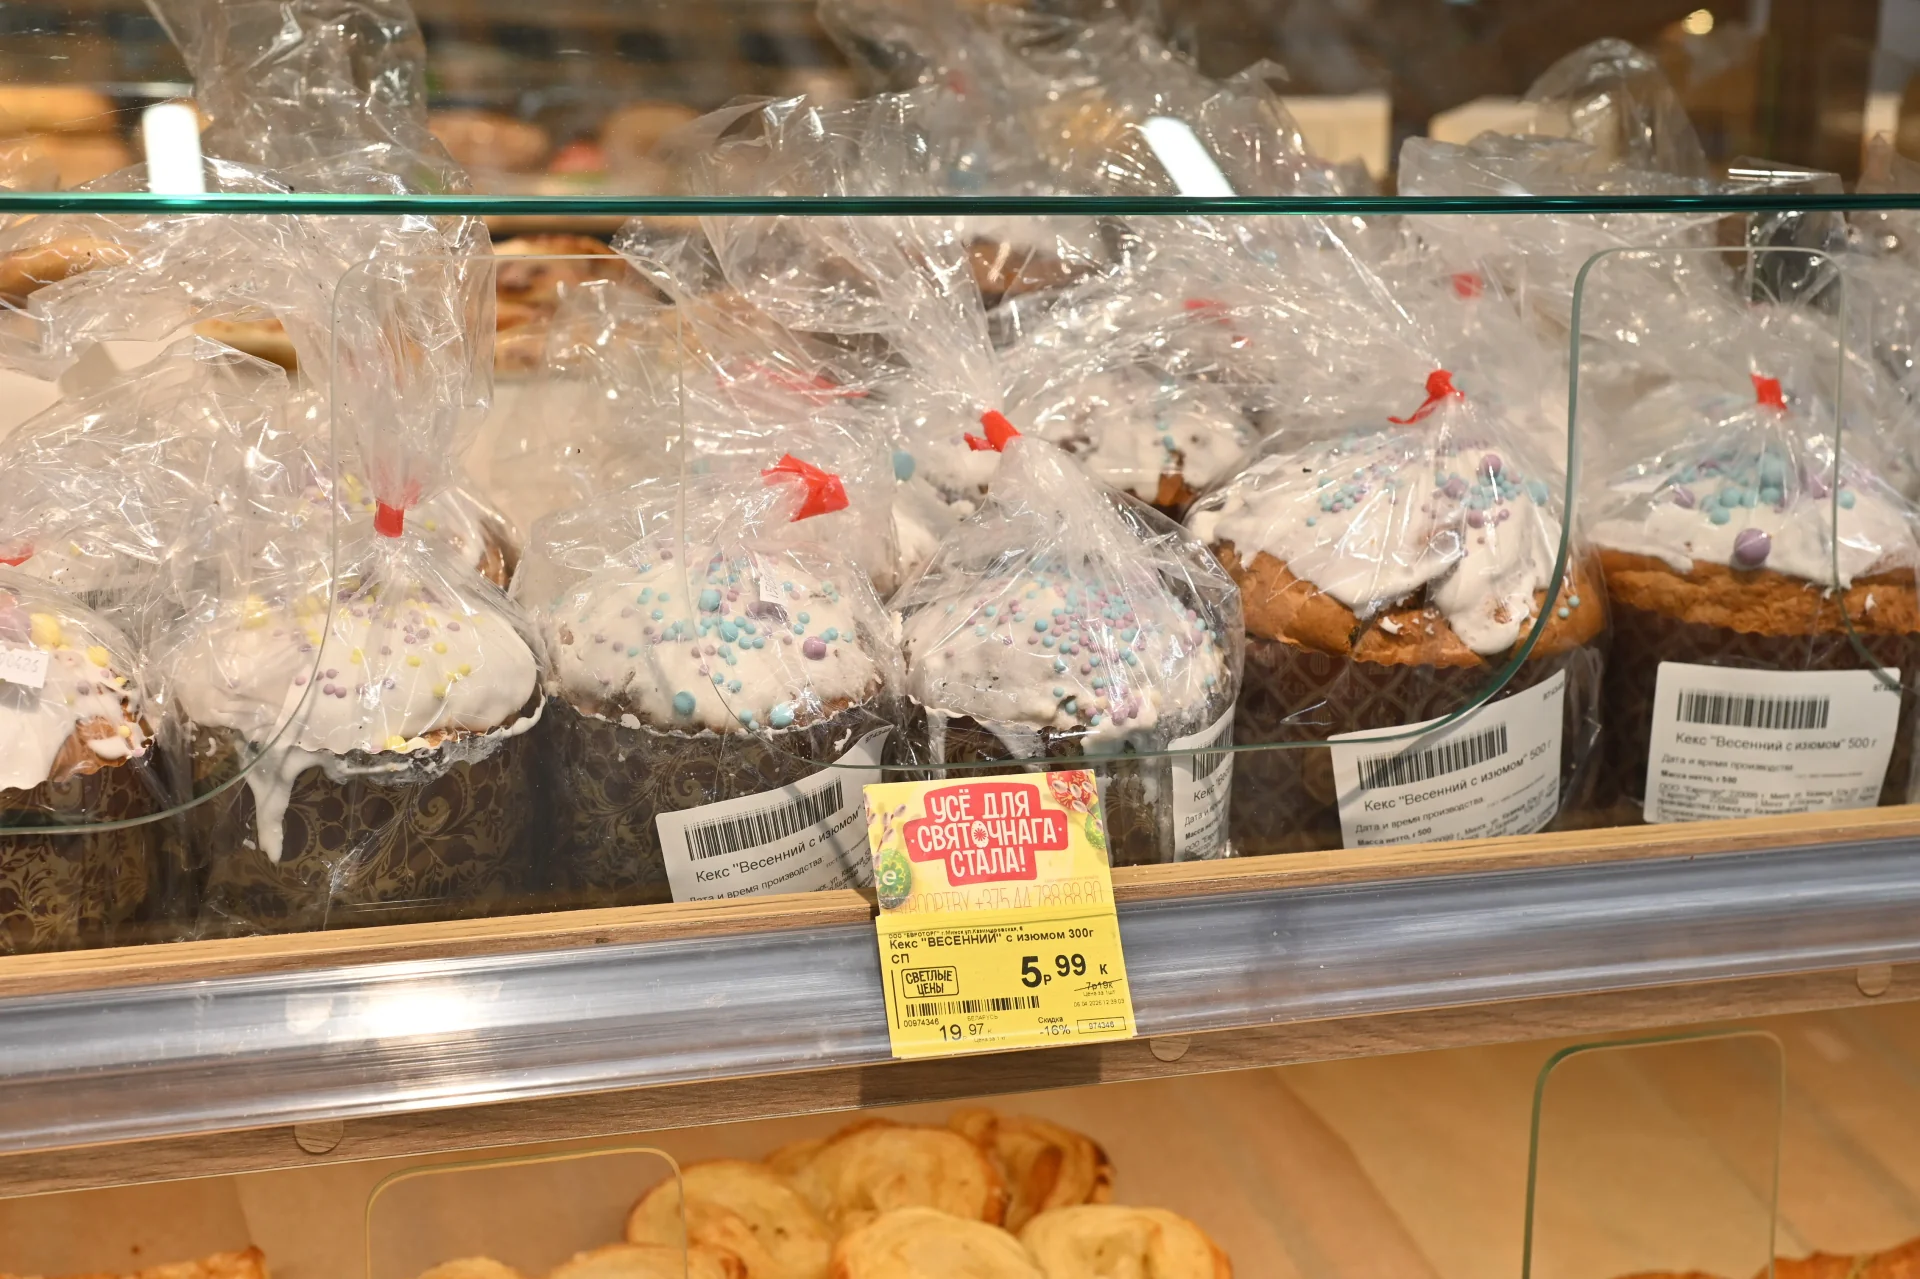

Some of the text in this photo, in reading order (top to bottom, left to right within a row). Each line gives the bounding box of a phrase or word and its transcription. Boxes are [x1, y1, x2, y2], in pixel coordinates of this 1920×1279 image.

[1676, 732, 1878, 752] Кекс "Весенний с изюмом" 500 г
[1364, 800, 1396, 813] Кекс
[1399, 779, 1468, 806] "Весенний
[1470, 777, 1478, 787] с
[1481, 753, 1528, 785] изюмом"
[1530, 742, 1547, 761] 500
[1194, 785, 1215, 803] Кекс
[931, 788, 1030, 822] УСЁ ДЛЯ
[1185, 812, 1203, 827] Дата
[1355, 822, 1380, 834] Дата
[1382, 821, 1388, 830] и
[1390, 815, 1421, 829] время
[917, 818, 1057, 853] СВЯТОЧНАГА
[1186, 826, 1204, 840] Масса
[1357, 837, 1384, 847] Масса
[1418, 827, 1432, 837] 500
[696, 865, 730, 883] Кекс
[733, 842, 806, 874] "Весенний
[809, 838, 816, 848] с
[819, 804, 861, 843] изюмом"
[950, 846, 1027, 878] СТАЛА!
[727, 884, 759, 899] время
[889, 939, 918, 950] Кекс
[1006, 934, 1013, 943] с
[1017, 932, 1066, 942] изюмом
[1068, 928, 1094, 939] 300г
[891, 953, 910, 965] СП
[1055, 953, 1086, 977] 99
[905, 969, 953, 985] СВЕТЛЫЕ
[916, 982, 944, 996] ЦЕНЫ
[904, 1018, 939, 1028] 00974346
[940, 1024, 962, 1042] 19
[969, 1023, 984, 1036] 97
[1040, 1024, 1071, 1036] -16%
[1089, 1021, 1115, 1030] 974346
